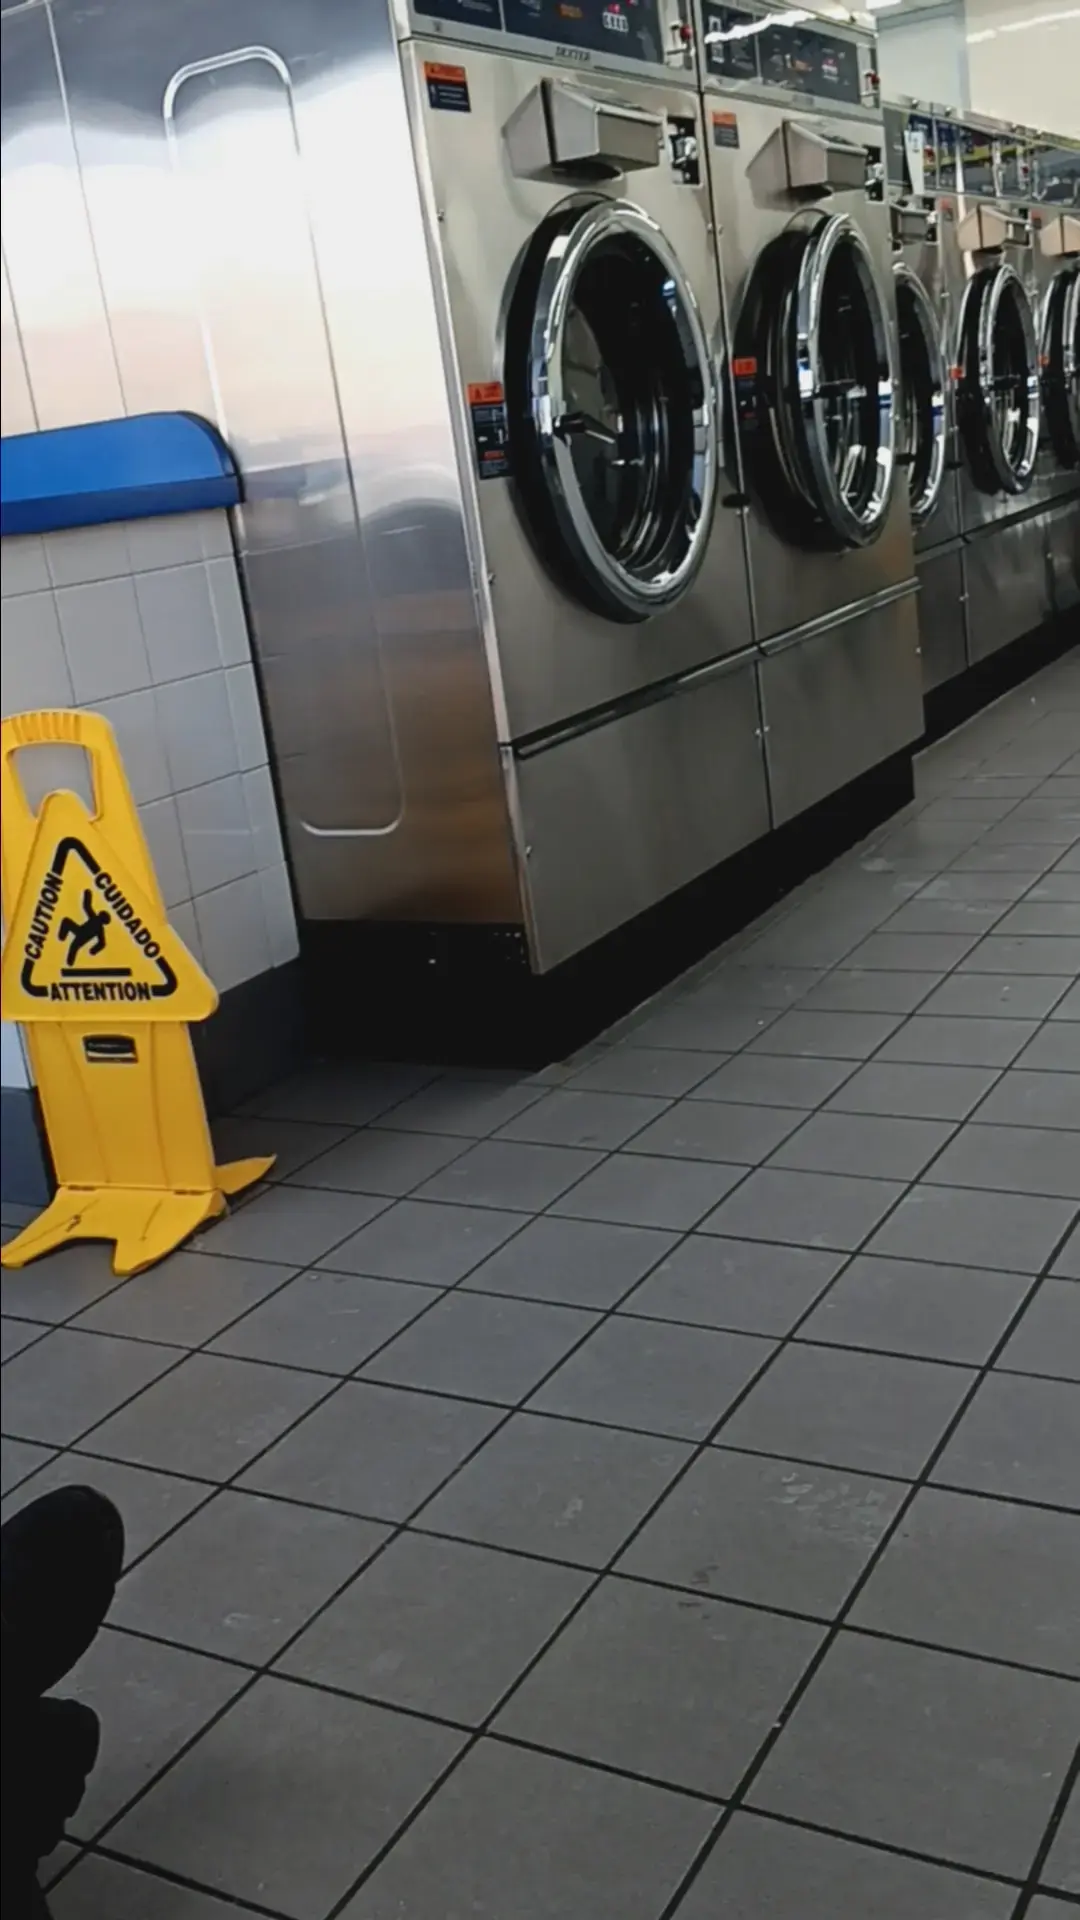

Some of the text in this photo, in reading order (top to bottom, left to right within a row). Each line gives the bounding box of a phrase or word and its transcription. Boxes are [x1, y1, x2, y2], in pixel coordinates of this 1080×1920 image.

[24, 872, 63, 959] CAUTION
[94, 872, 161, 959] CUIDADO
[51, 982, 151, 1001] ATTENTION
